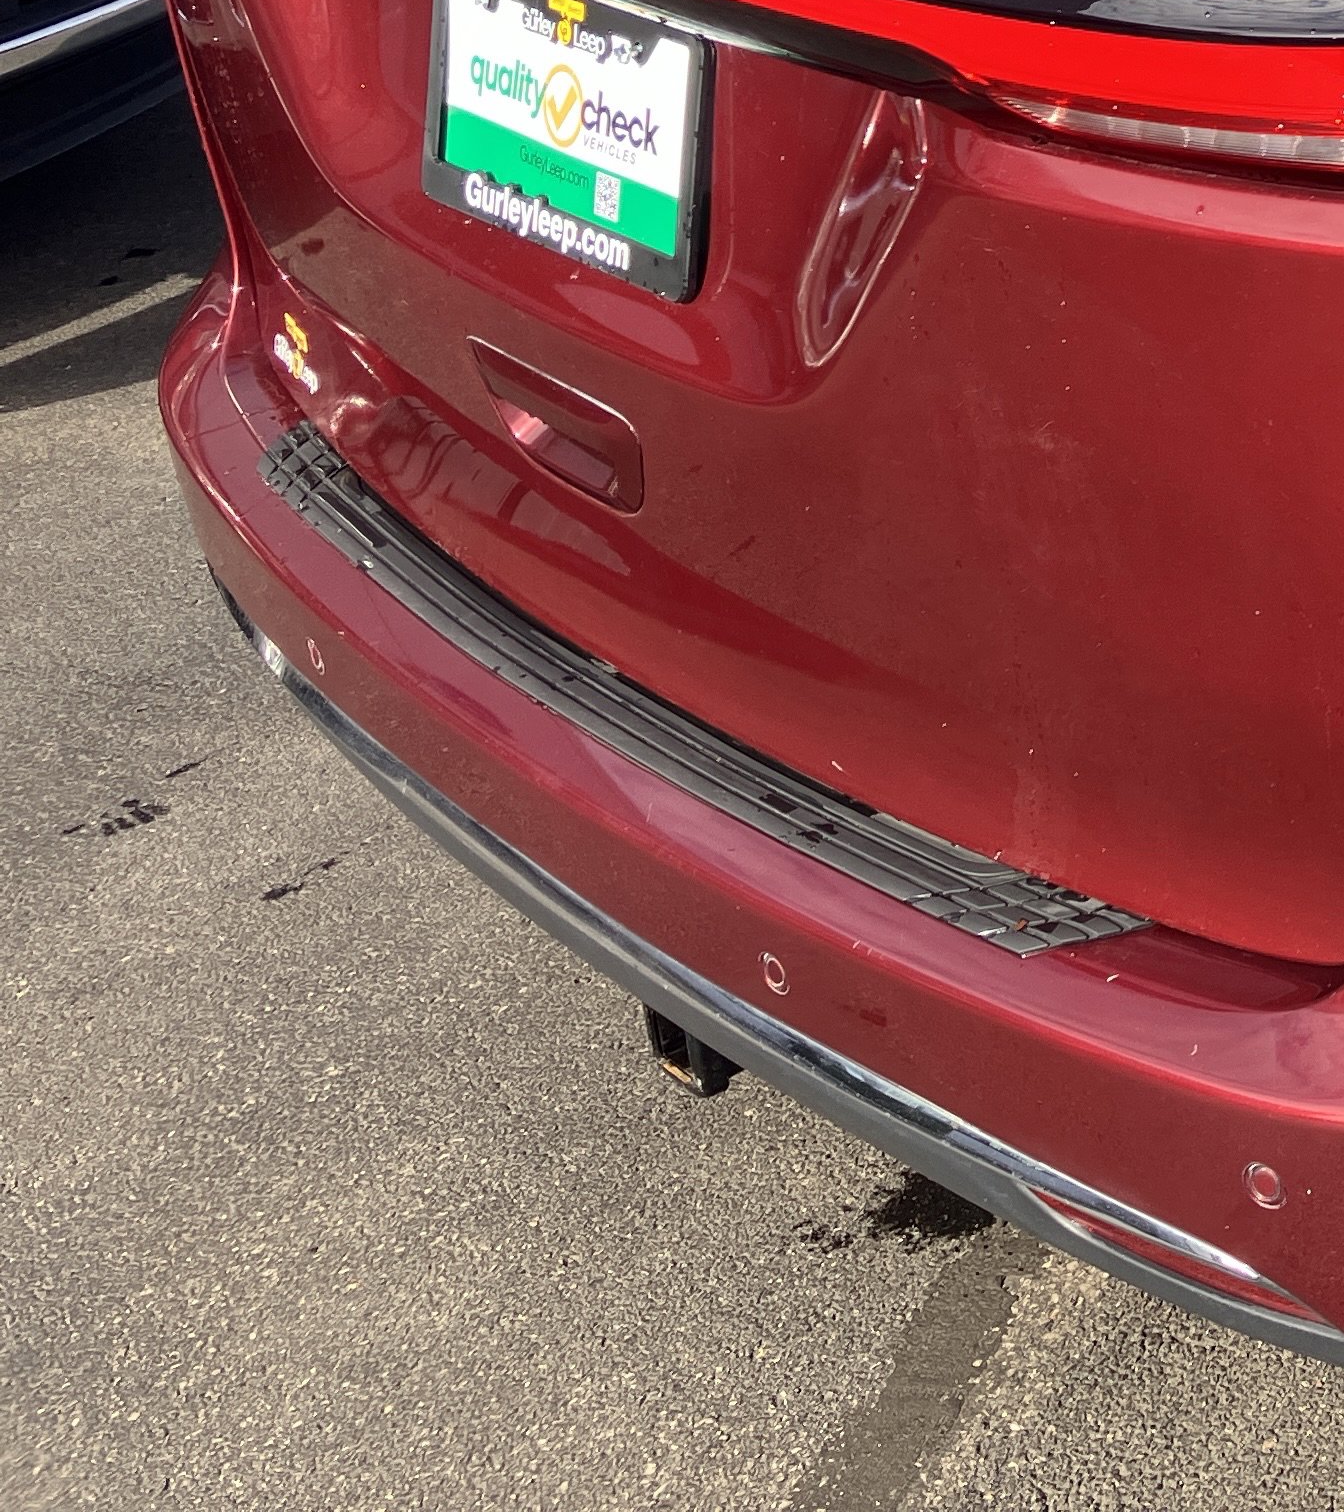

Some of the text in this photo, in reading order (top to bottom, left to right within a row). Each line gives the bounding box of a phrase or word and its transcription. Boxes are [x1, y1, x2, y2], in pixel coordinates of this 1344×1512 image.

[573, 23, 606, 59] Leep
[470, 53, 661, 156] quality check
[583, 136, 637, 166] VEHICLES
[465, 172, 631, 271] Gurleyleep.com
